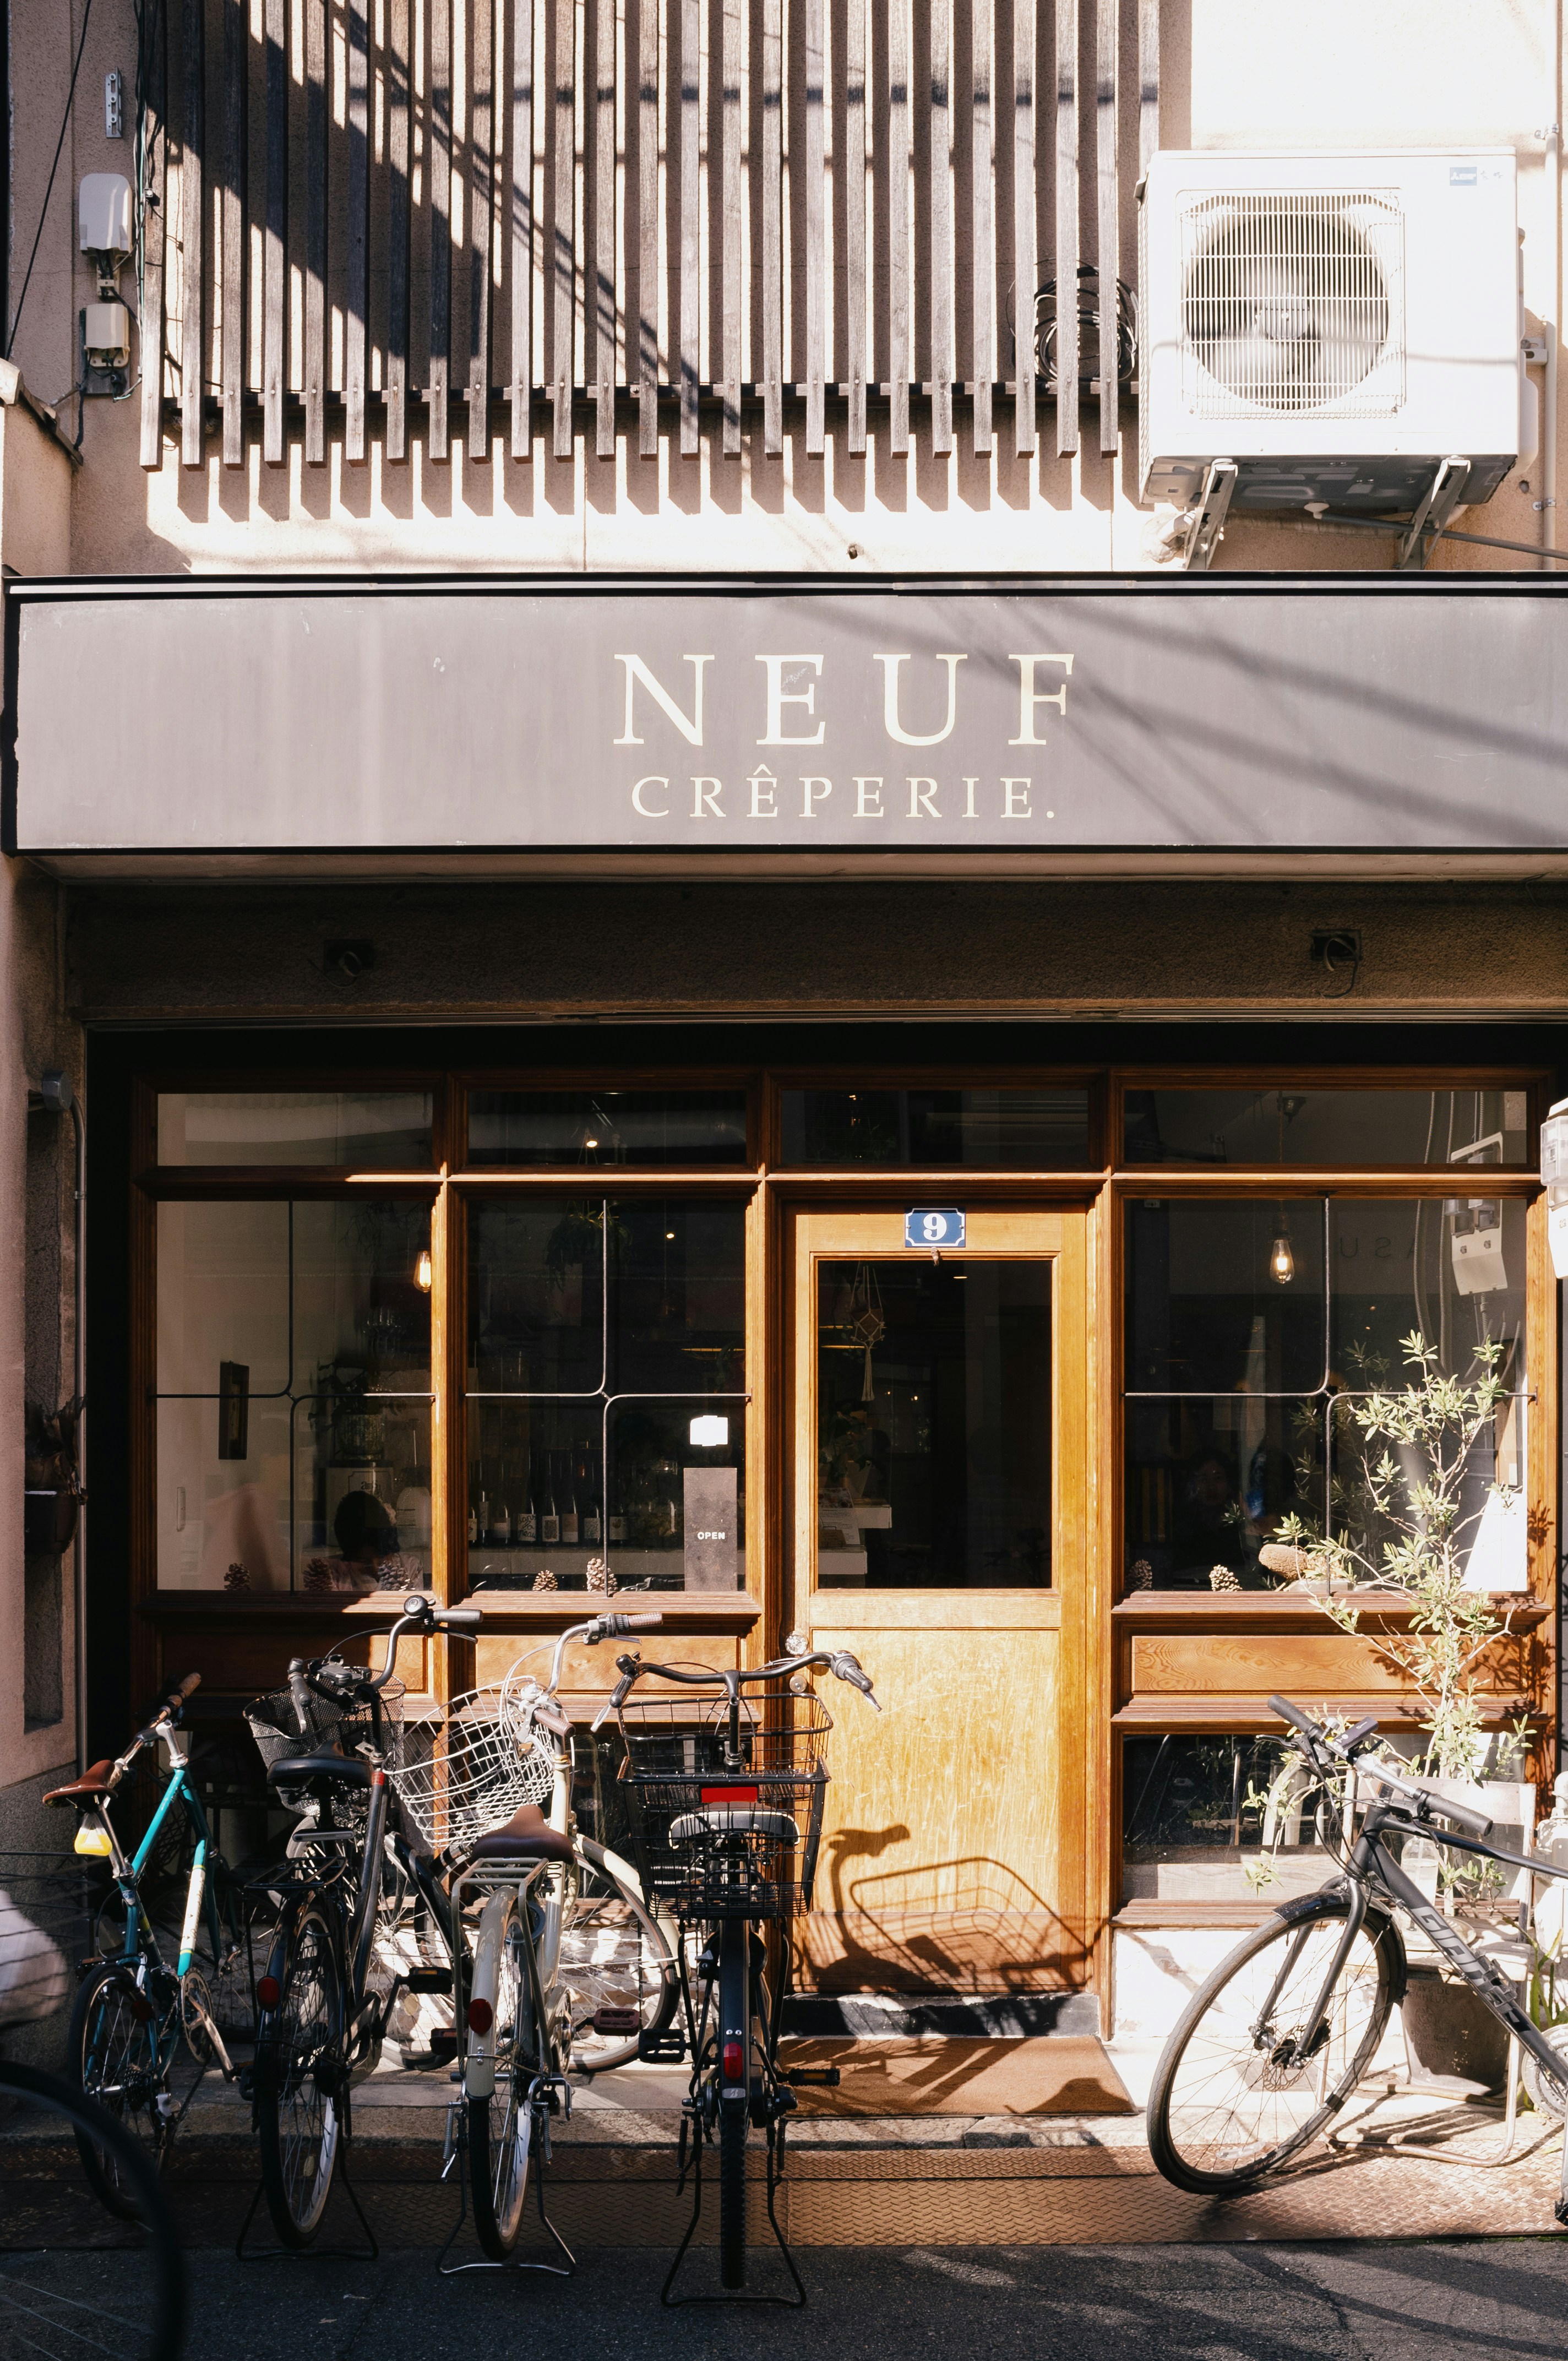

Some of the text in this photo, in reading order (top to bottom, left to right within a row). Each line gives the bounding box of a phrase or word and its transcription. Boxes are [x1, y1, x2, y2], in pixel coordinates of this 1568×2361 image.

[613, 654, 1075, 747] NEUF
[630, 764, 1055, 819] CRÊPERIE.
[923, 1212, 947, 1241] 9
[697, 1531, 726, 1540] OPEN
